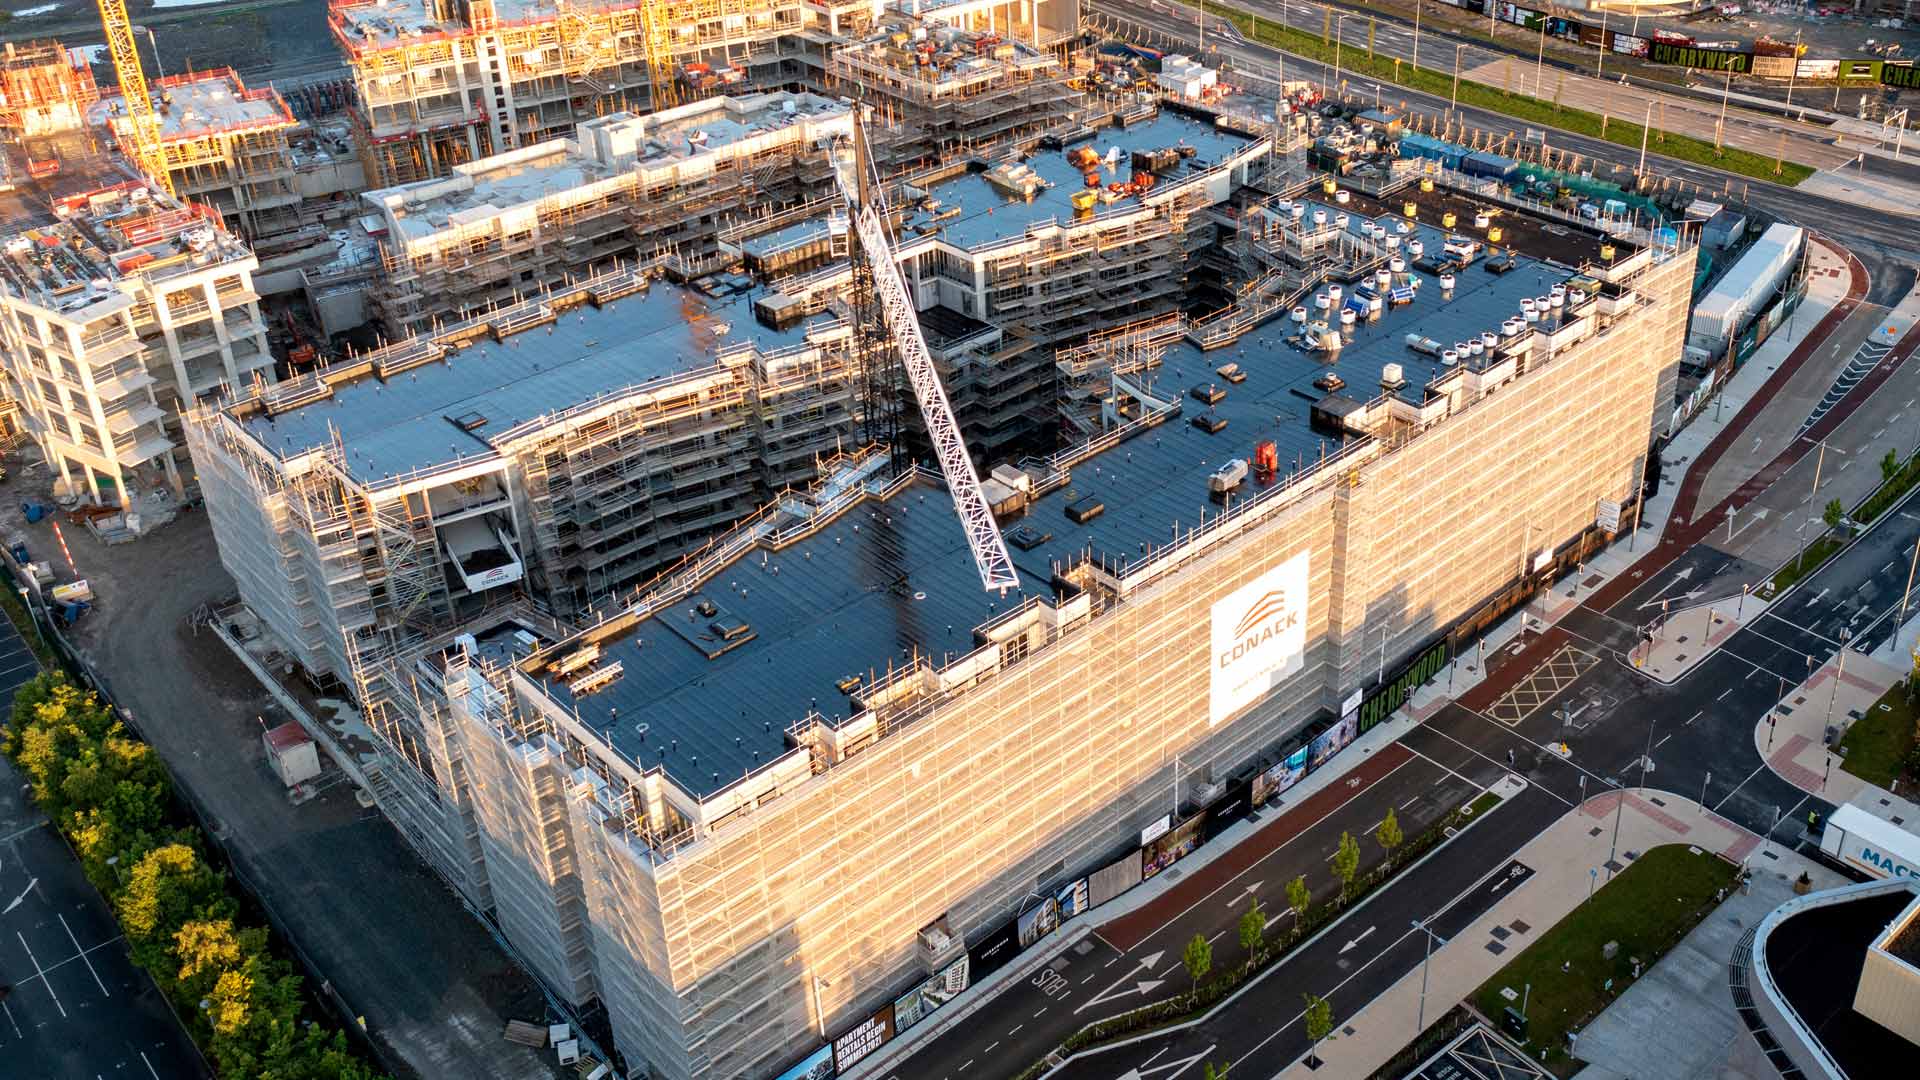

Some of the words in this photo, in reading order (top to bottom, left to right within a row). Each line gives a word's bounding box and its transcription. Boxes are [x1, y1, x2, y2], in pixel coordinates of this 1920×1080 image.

[1654, 44, 1746, 71] CHERRYWOOD
[1220, 610, 1298, 669] CONACK
[1361, 643, 1446, 733] CHERRYWOOD
[1031, 968, 1068, 996] BUS
[836, 1017, 875, 1049] APARTMENT
[837, 1034, 866, 1061] RENTALS
[866, 1020, 886, 1040] BEGIN
[838, 1045, 867, 1071] SUMMER
[867, 1034, 882, 1051] 2021
